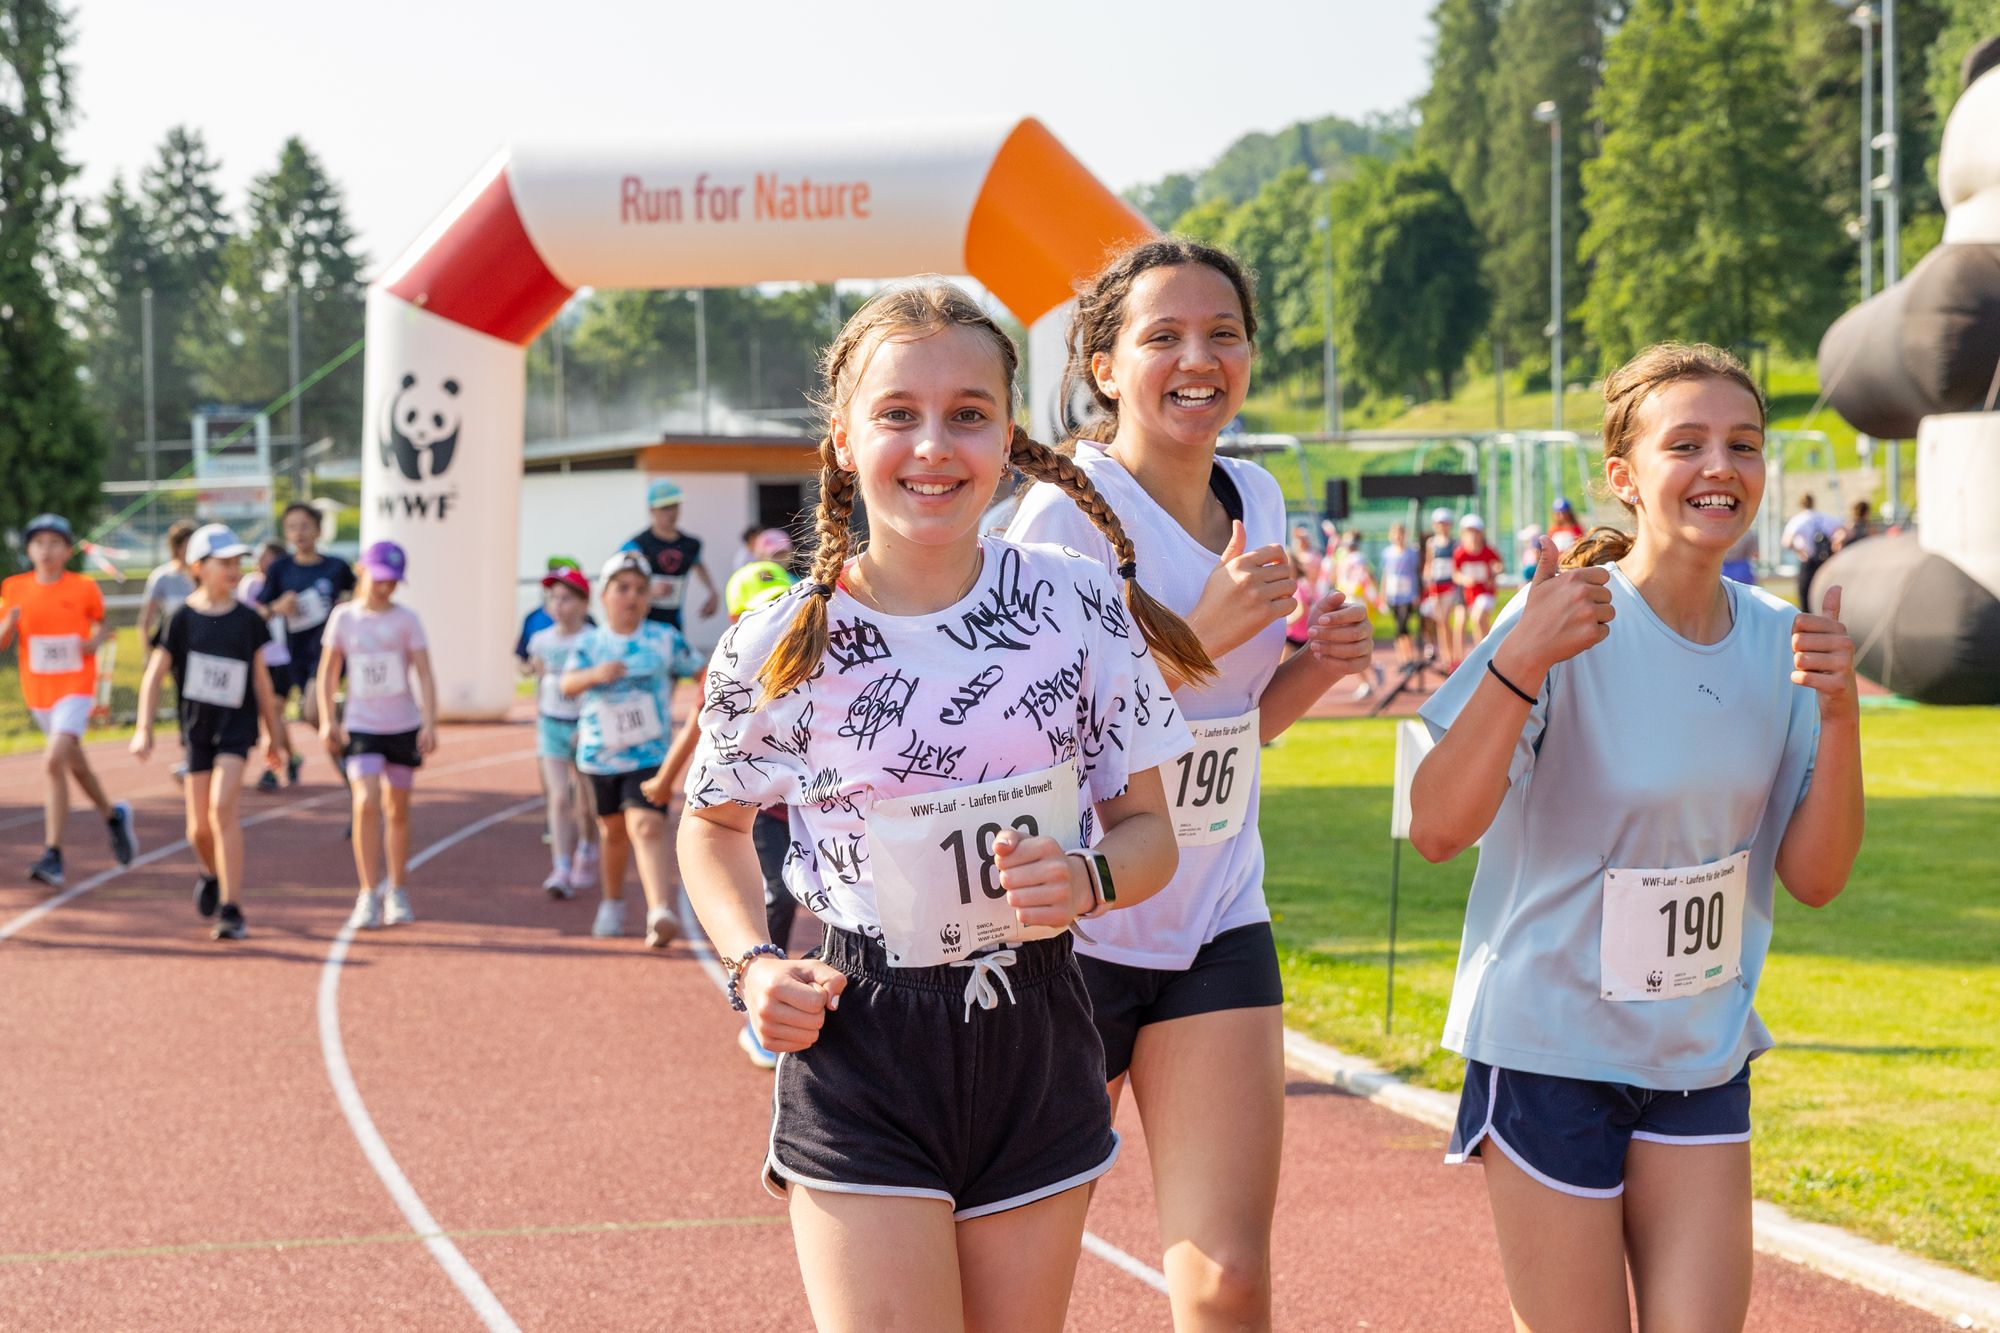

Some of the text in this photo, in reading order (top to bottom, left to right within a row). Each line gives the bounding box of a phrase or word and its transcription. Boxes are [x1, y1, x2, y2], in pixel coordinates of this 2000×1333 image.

[621, 172, 872, 223] Run for Nature
[378, 494, 459, 519] WWF
[1176, 747, 1239, 807] 196
[910, 799, 957, 817] WWF-Lauf
[969, 793, 997, 808] Laufen
[999, 790, 1010, 803] für
[1011, 788, 1024, 799] die
[1024, 779, 1053, 797] Umwelt
[1642, 876, 1677, 887] WWF-Lauf
[1686, 874, 1705, 885] Laufen
[1705, 872, 1713, 881] für
[1659, 891, 1724, 957] 190
[942, 945, 962, 955] WWF
